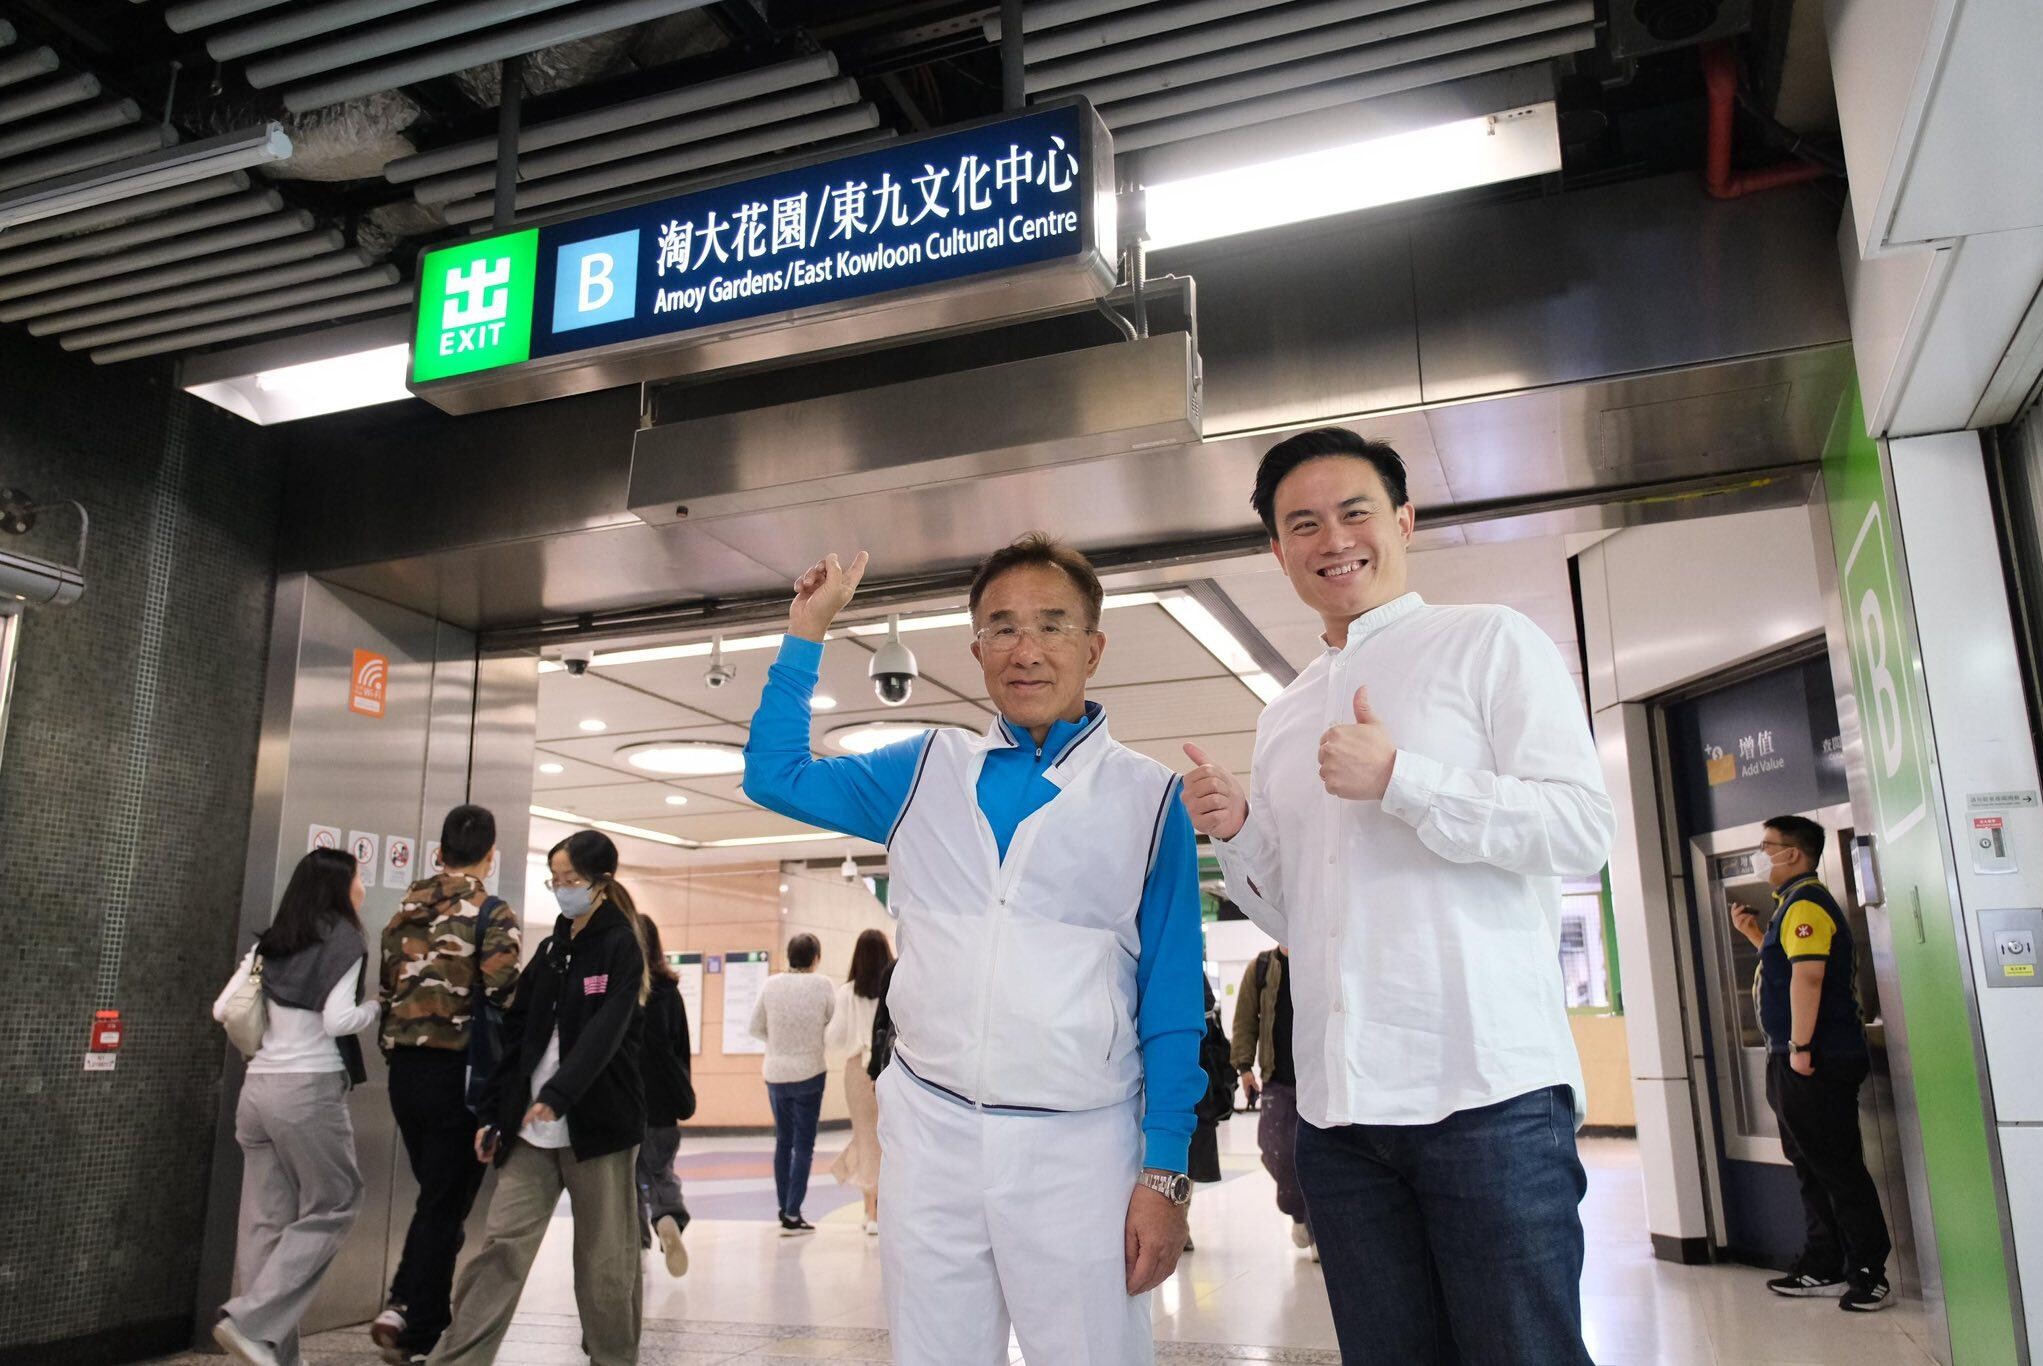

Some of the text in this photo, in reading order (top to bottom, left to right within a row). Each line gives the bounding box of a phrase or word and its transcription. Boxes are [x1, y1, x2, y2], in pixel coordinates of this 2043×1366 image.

[656, 135, 1079, 277] 淘大花園/東九文化中心
[577, 251, 615, 313] B
[653, 286, 707, 315] Amoy
[836, 243, 922, 279] Kowloon
[925, 217, 1004, 256] Cultural
[1007, 208, 1078, 242] Centre
[439, 322, 506, 357] EXIT
[1860, 588, 1903, 779] B
[1738, 731, 1774, 760] 增值
[1741, 758, 1784, 777] Add Value
